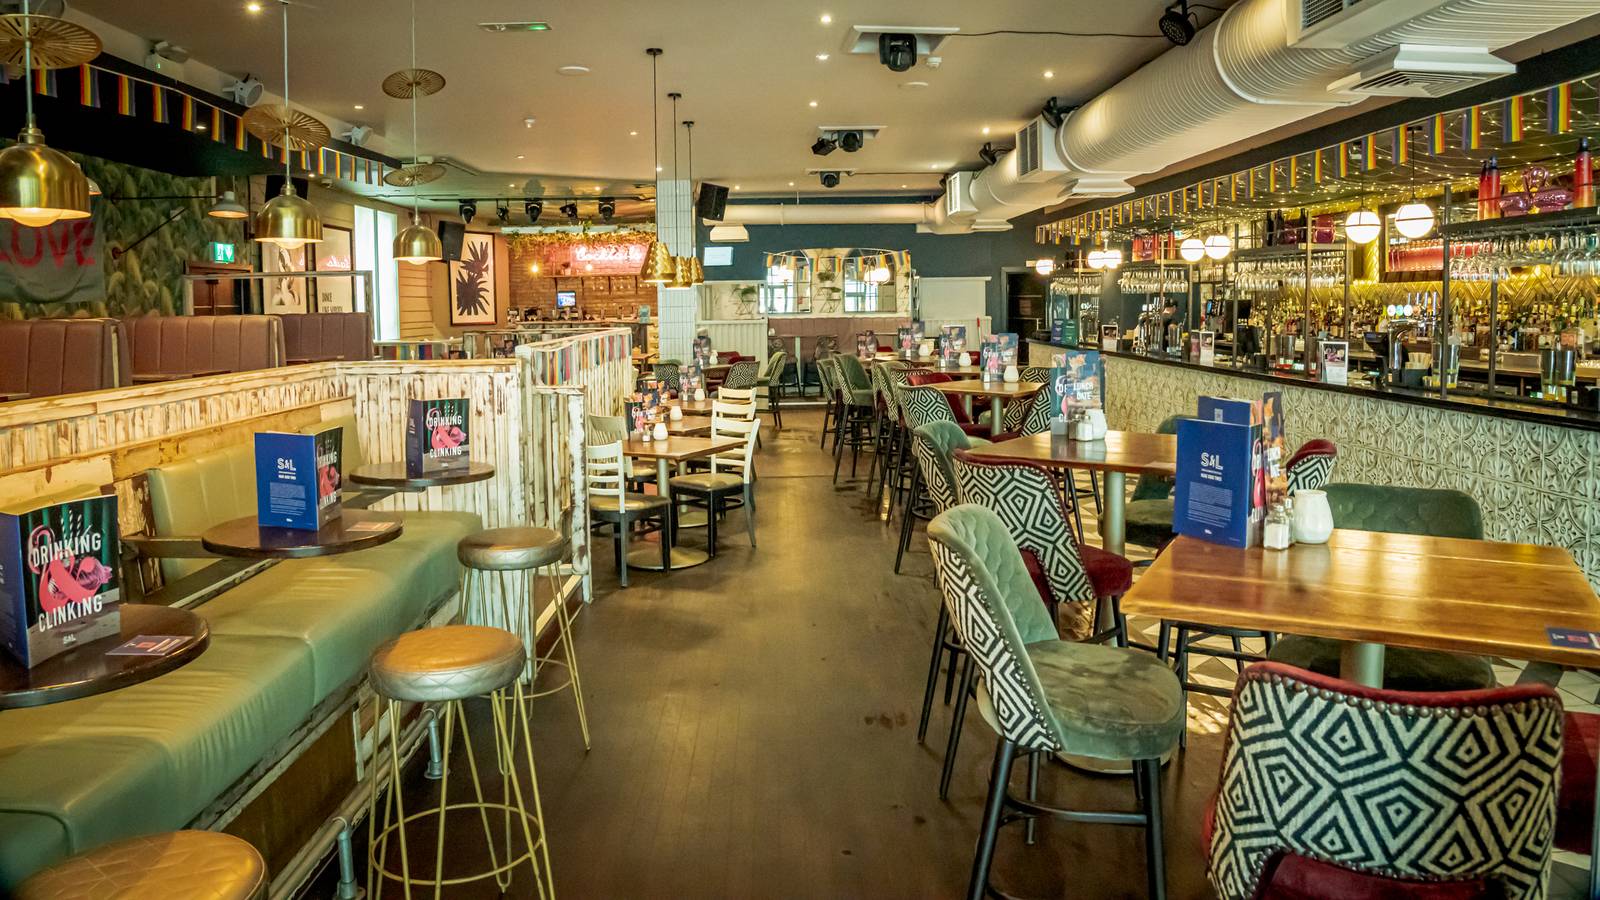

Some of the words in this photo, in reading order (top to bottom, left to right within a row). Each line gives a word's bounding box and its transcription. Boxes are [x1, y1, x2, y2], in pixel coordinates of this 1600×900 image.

[428, 415, 463, 427] DRINKING
[429, 446, 463, 458] CLINKING
[277, 457, 297, 471] S&L
[1200, 452, 1224, 471] S&L
[32, 532, 102, 567] DRINKING
[38, 594, 103, 633] CLINKING
